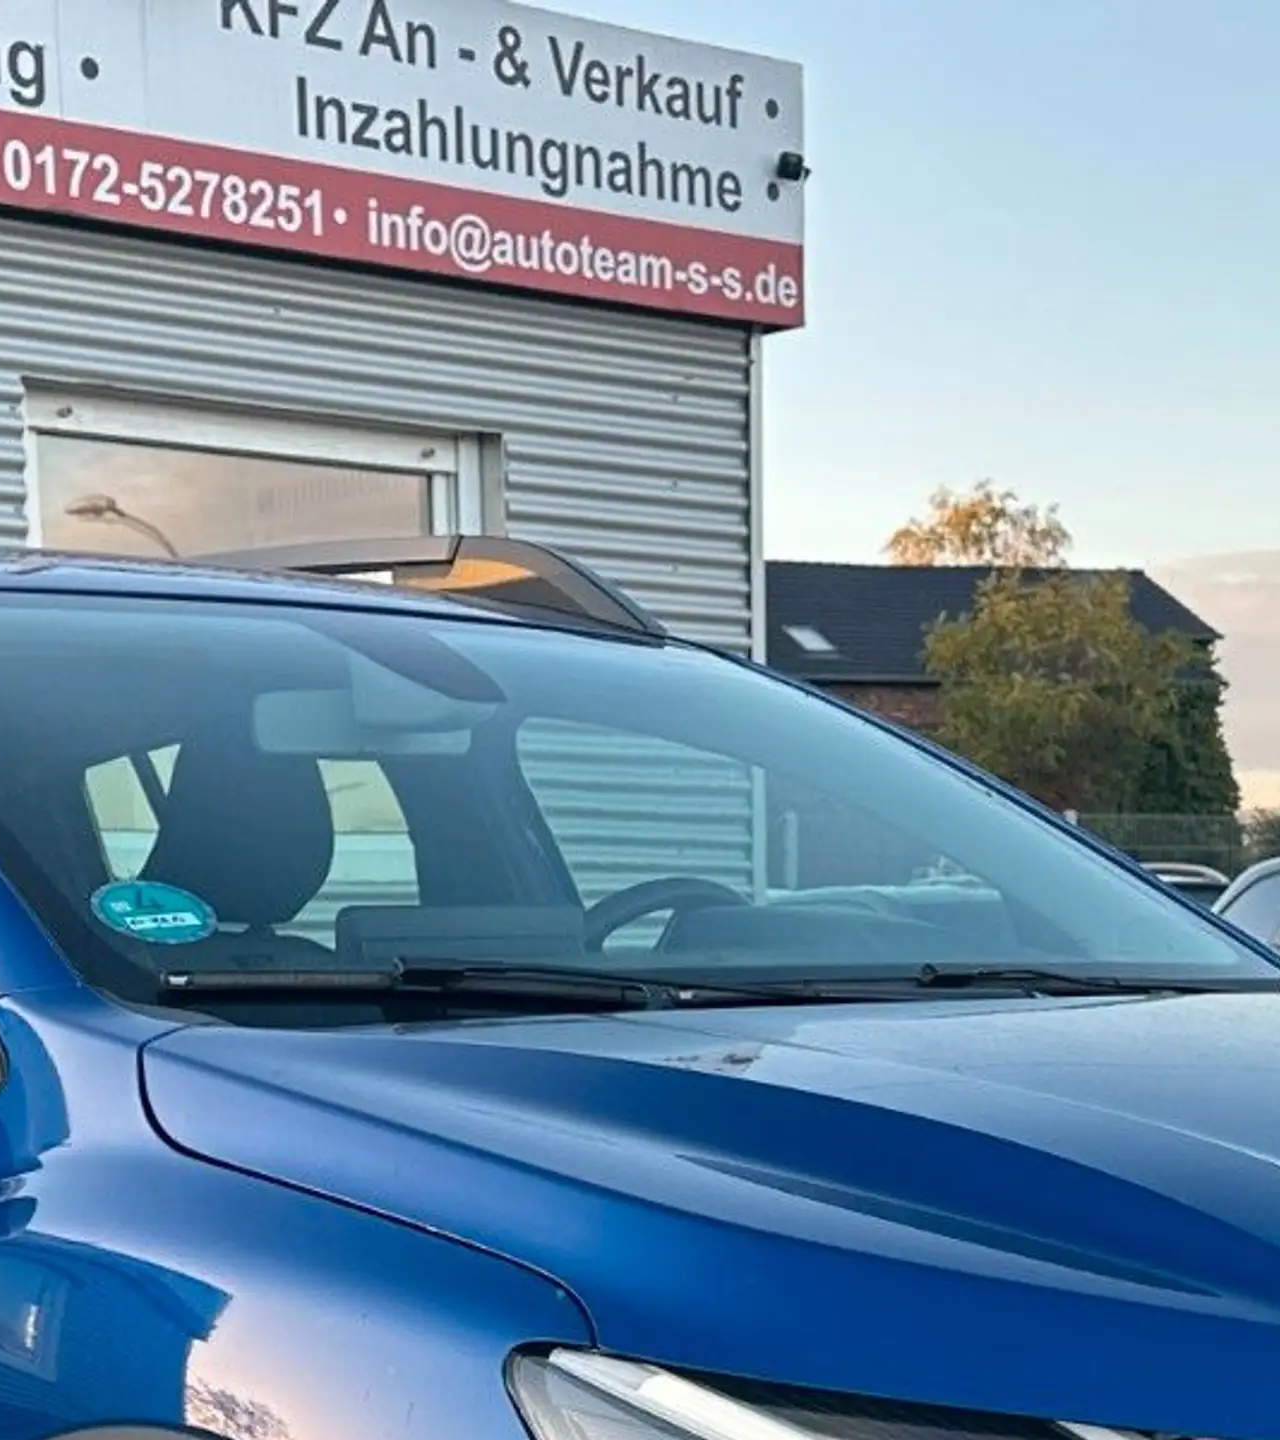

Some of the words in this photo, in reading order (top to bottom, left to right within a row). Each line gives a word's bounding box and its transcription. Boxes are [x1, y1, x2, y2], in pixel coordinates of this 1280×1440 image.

[358, 0, 437, 69] An
[493, 25, 532, 89] &
[548, 35, 746, 130] Verkauf
[295, 75, 744, 213] Inzahlungnahme
[2, 138, 324, 238] 0172-5278251
[366, 198, 799, 309] info@autoteam-s-s.de
